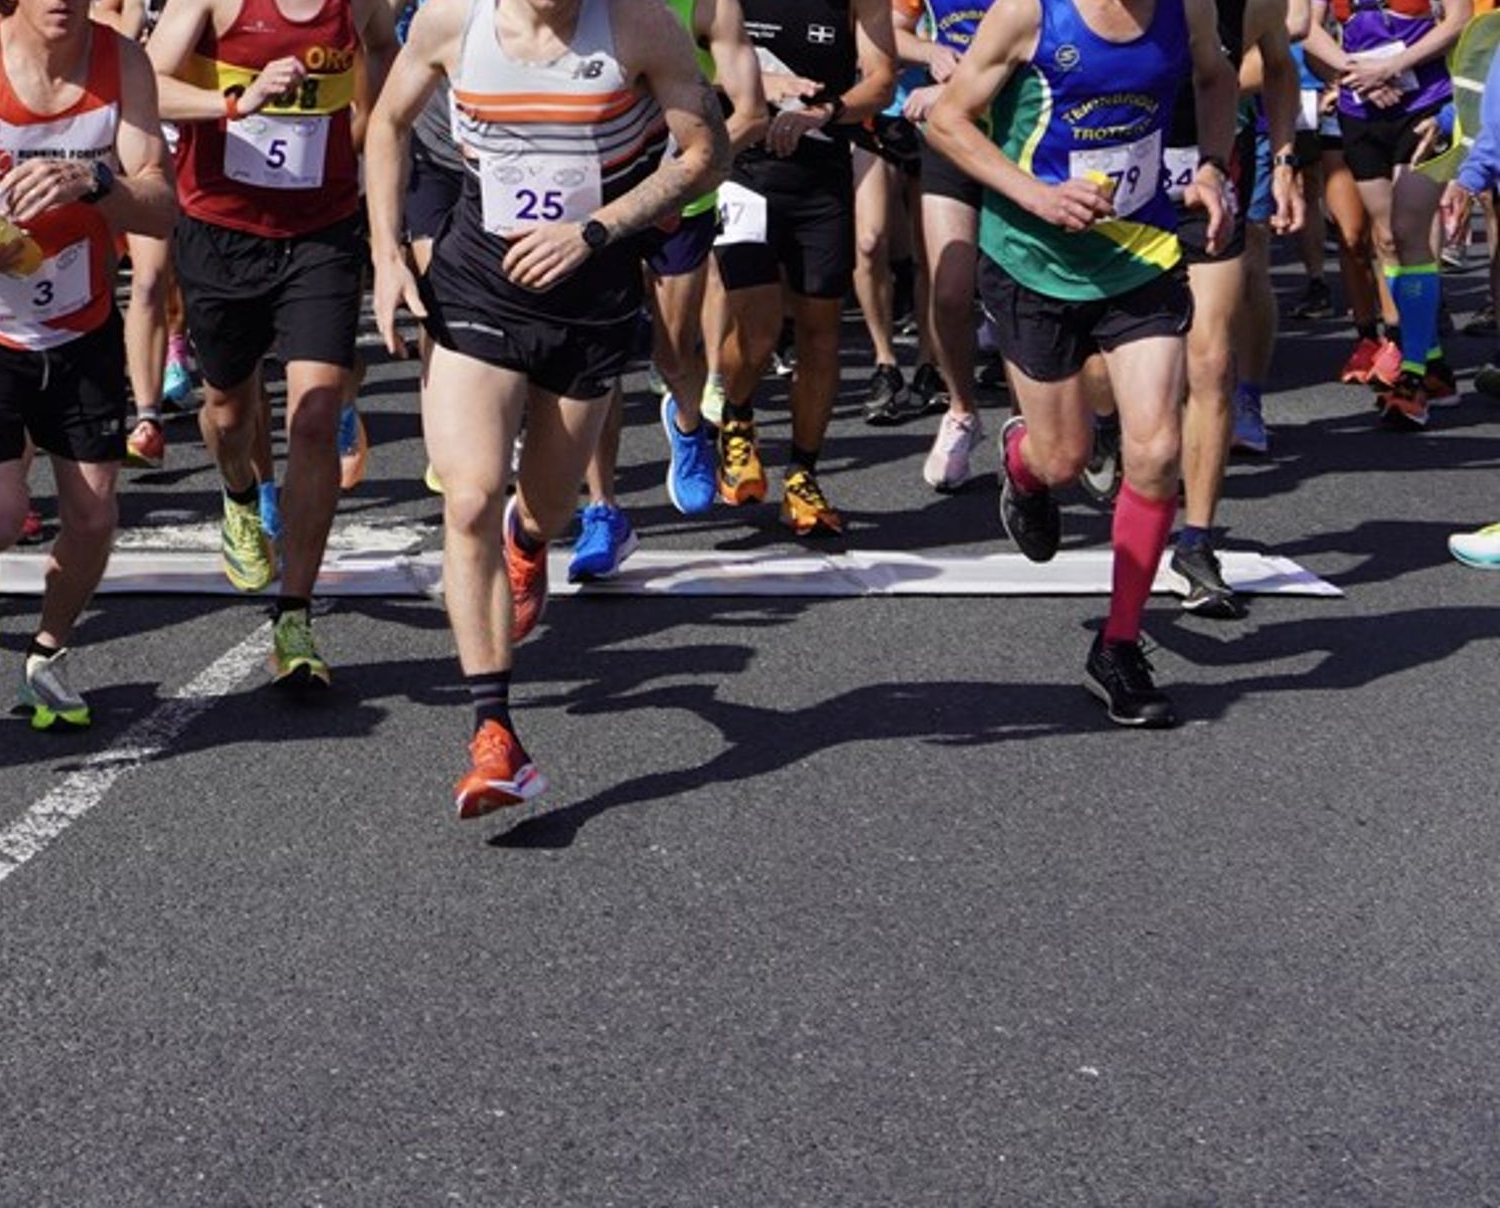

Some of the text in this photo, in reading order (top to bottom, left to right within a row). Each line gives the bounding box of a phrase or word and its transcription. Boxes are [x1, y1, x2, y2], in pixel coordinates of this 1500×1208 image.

[17, 148, 67, 159] RUNNING
[265, 139, 288, 170] 5
[1107, 165, 1141, 195] 79
[515, 188, 565, 221] 25
[32, 279, 55, 306] 3
